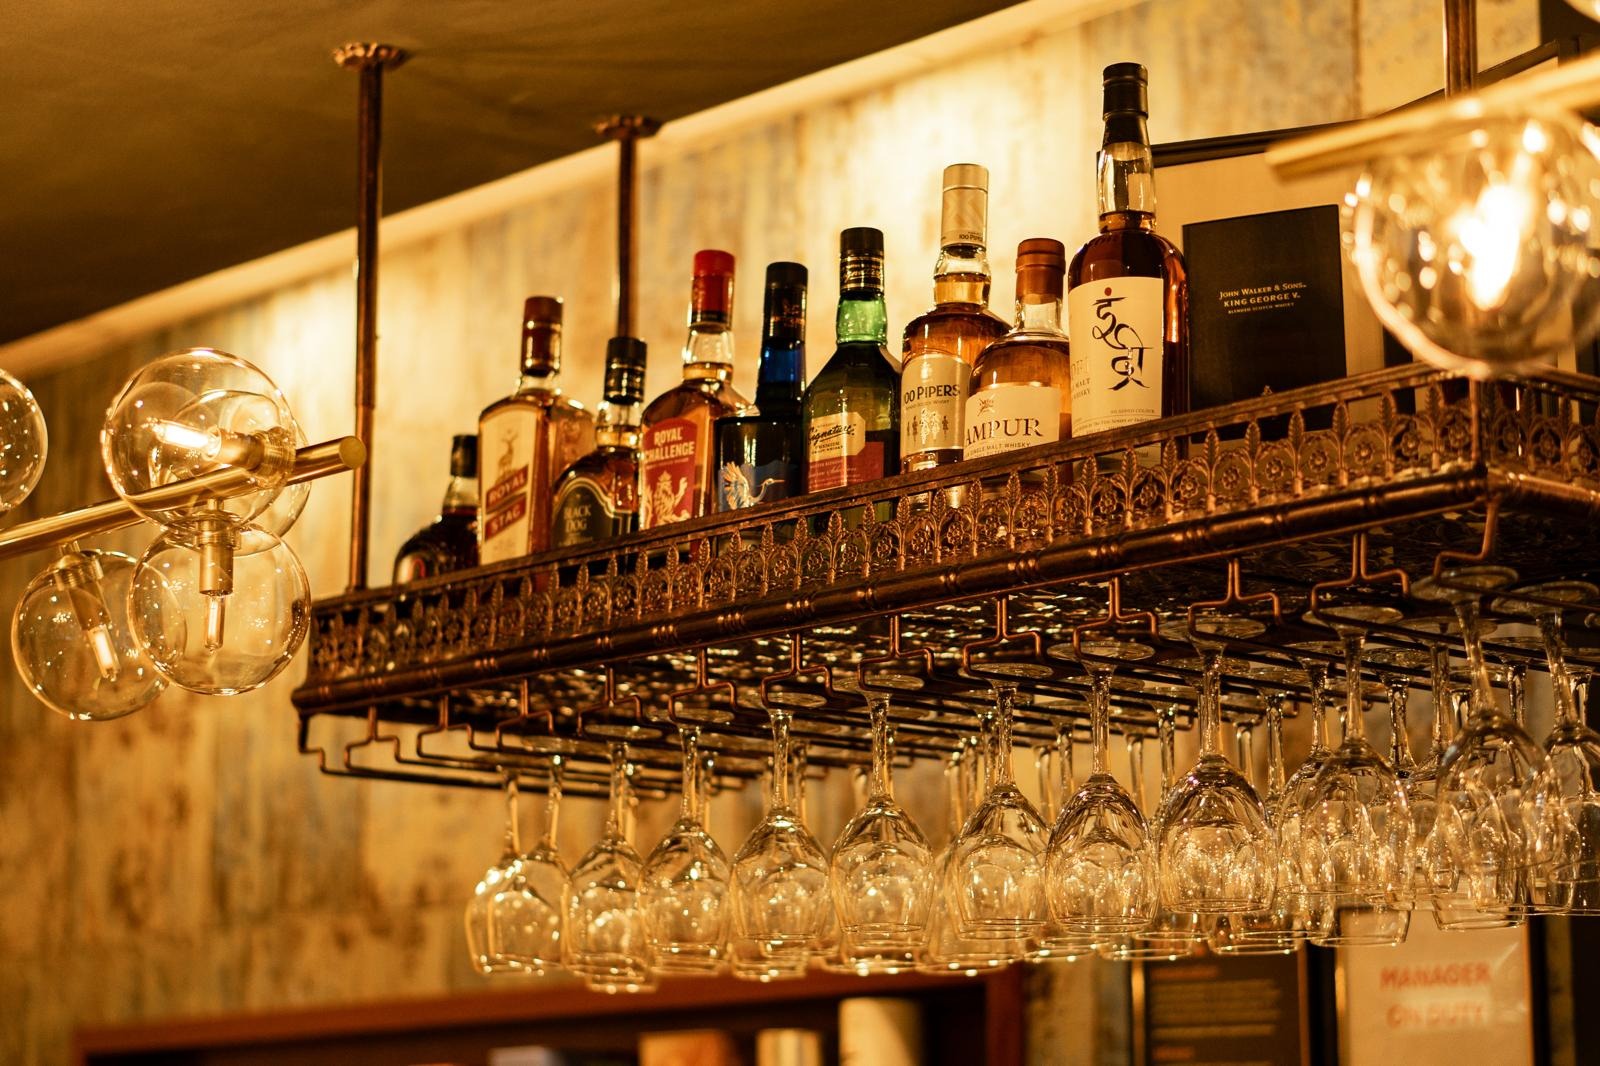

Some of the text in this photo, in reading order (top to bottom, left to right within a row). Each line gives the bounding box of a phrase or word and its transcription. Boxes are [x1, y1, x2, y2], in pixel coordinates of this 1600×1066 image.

[1219, 291, 1239, 300] JOHN
[1241, 286, 1272, 297] WALKER
[1223, 299, 1248, 308] KING
[1249, 293, 1290, 305] GEORGE
[917, 384, 961, 400] PIPERS
[653, 426, 684, 447] ROYAL
[488, 471, 526, 504] ROYAL
[490, 504, 522, 533] STAG
[564, 504, 592, 519] BLACK
[565, 518, 588, 533] DOG
[1379, 962, 1491, 991] MANAGER
